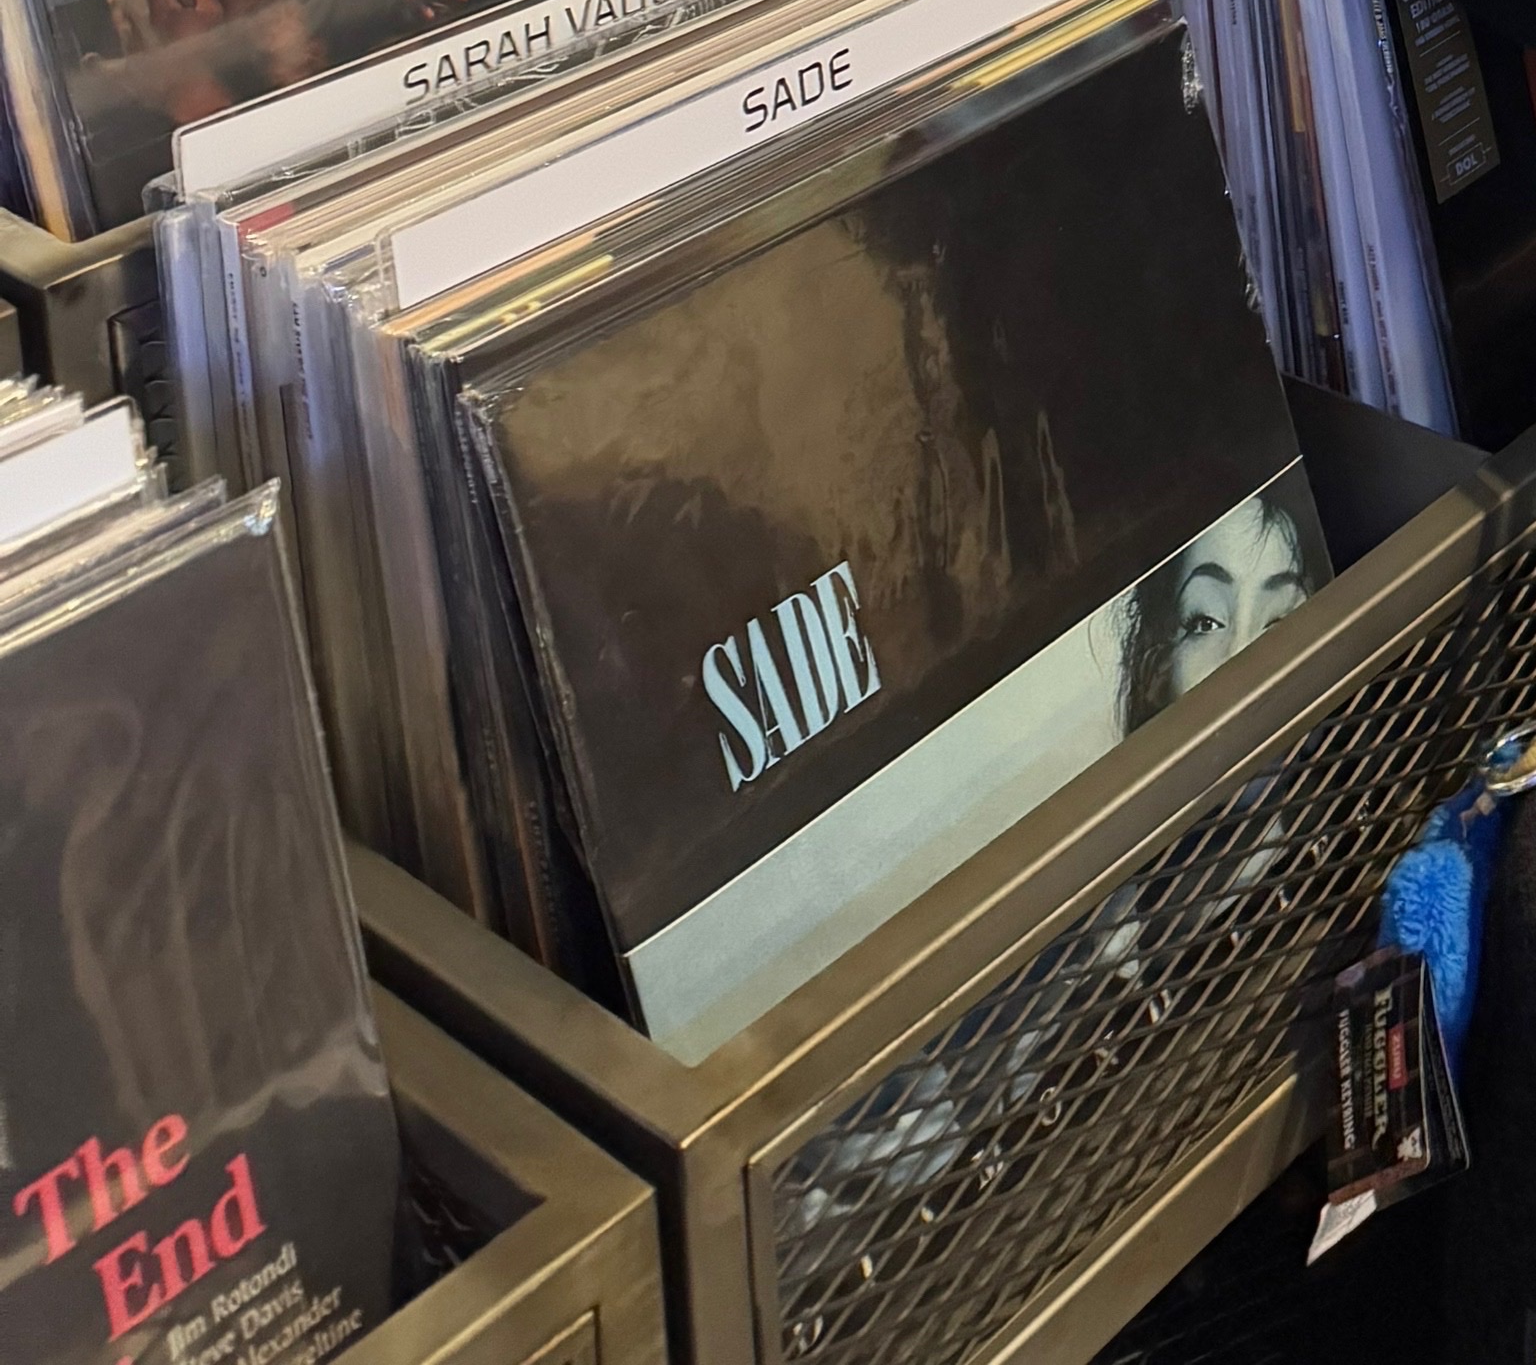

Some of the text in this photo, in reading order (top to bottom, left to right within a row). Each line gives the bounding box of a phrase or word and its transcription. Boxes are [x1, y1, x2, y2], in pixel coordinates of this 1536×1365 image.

[402, 21, 553, 106] SARAH
[741, 48, 855, 134] SADE
[1455, 153, 1478, 177] DOL
[702, 559, 881, 793] SADE
[1340, 1079, 1356, 1150] KEYRING
[12, 1113, 192, 1265] The
[92, 1153, 269, 1342] End
[166, 1241, 298, 1362] Jim Rotondi
[239, 1279, 305, 1340] Davis
